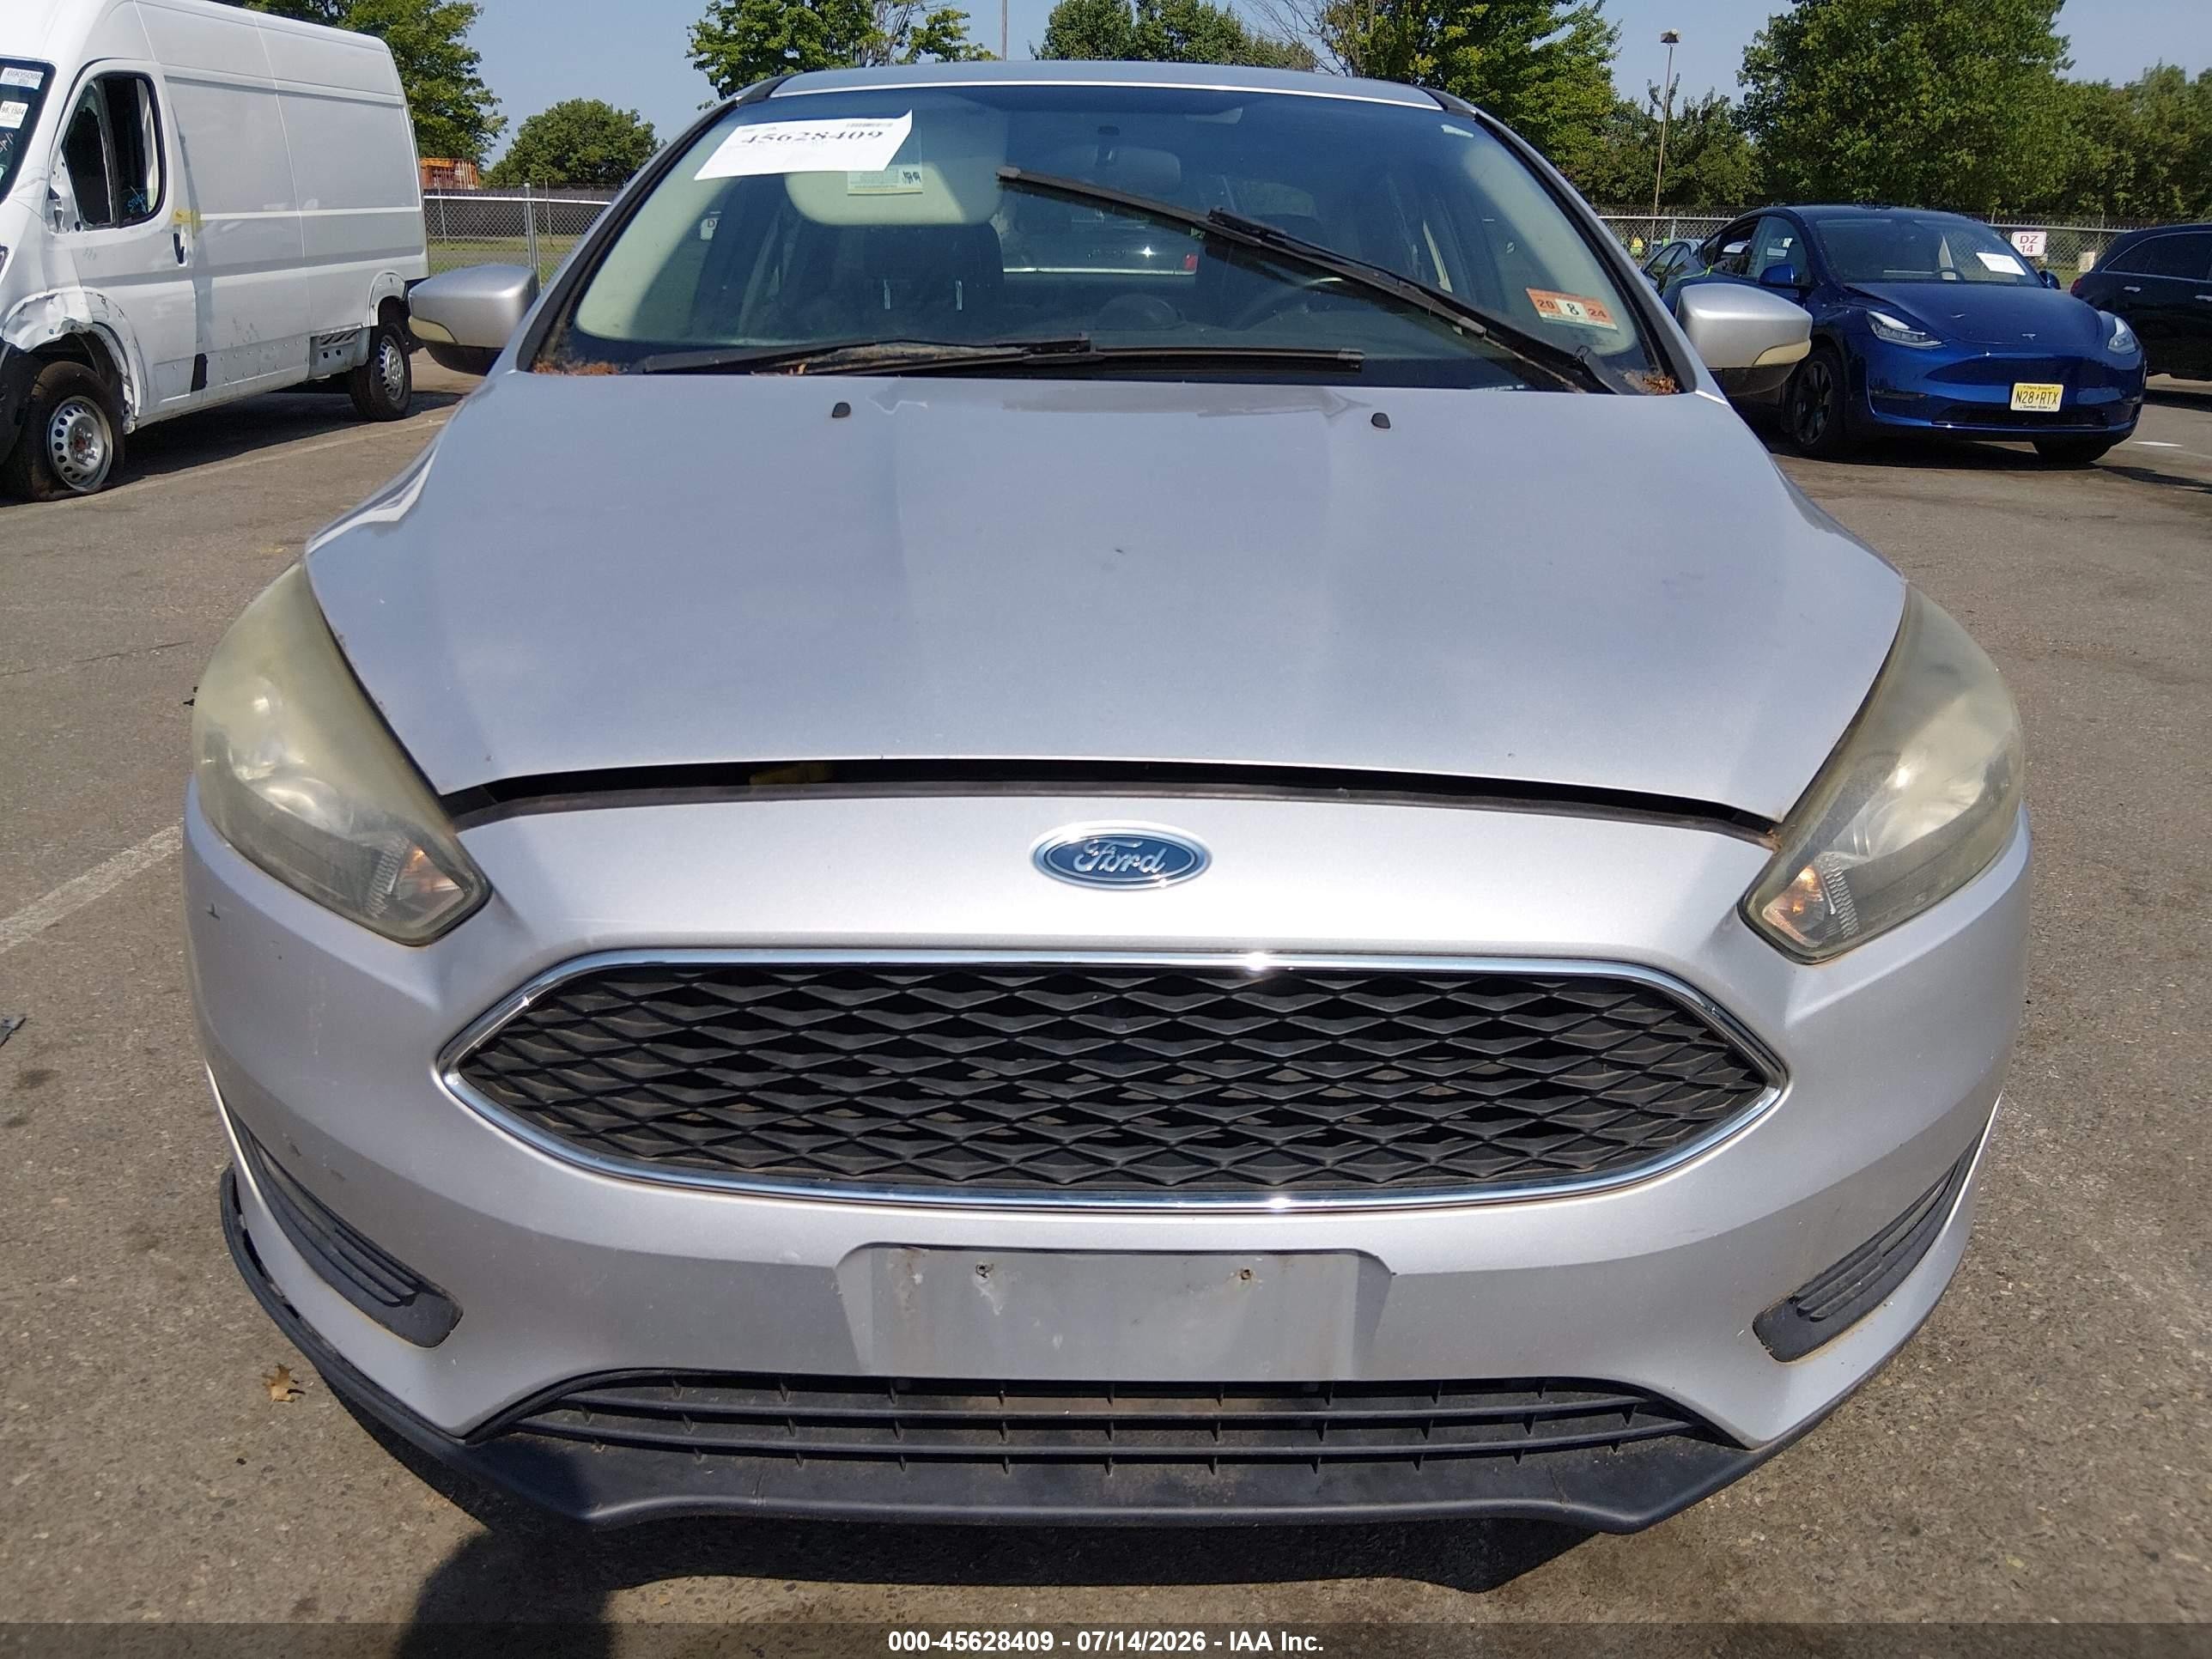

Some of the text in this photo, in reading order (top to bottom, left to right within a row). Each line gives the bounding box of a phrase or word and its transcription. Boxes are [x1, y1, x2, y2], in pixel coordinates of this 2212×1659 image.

[741, 130, 884, 144] 45628409
[2019, 235, 2039, 245] DZ
[2021, 245, 2034, 253] 14
[1537, 300, 1555, 310] 20
[1566, 302, 1580, 316] 8
[1073, 838, 1168, 873] Ford
